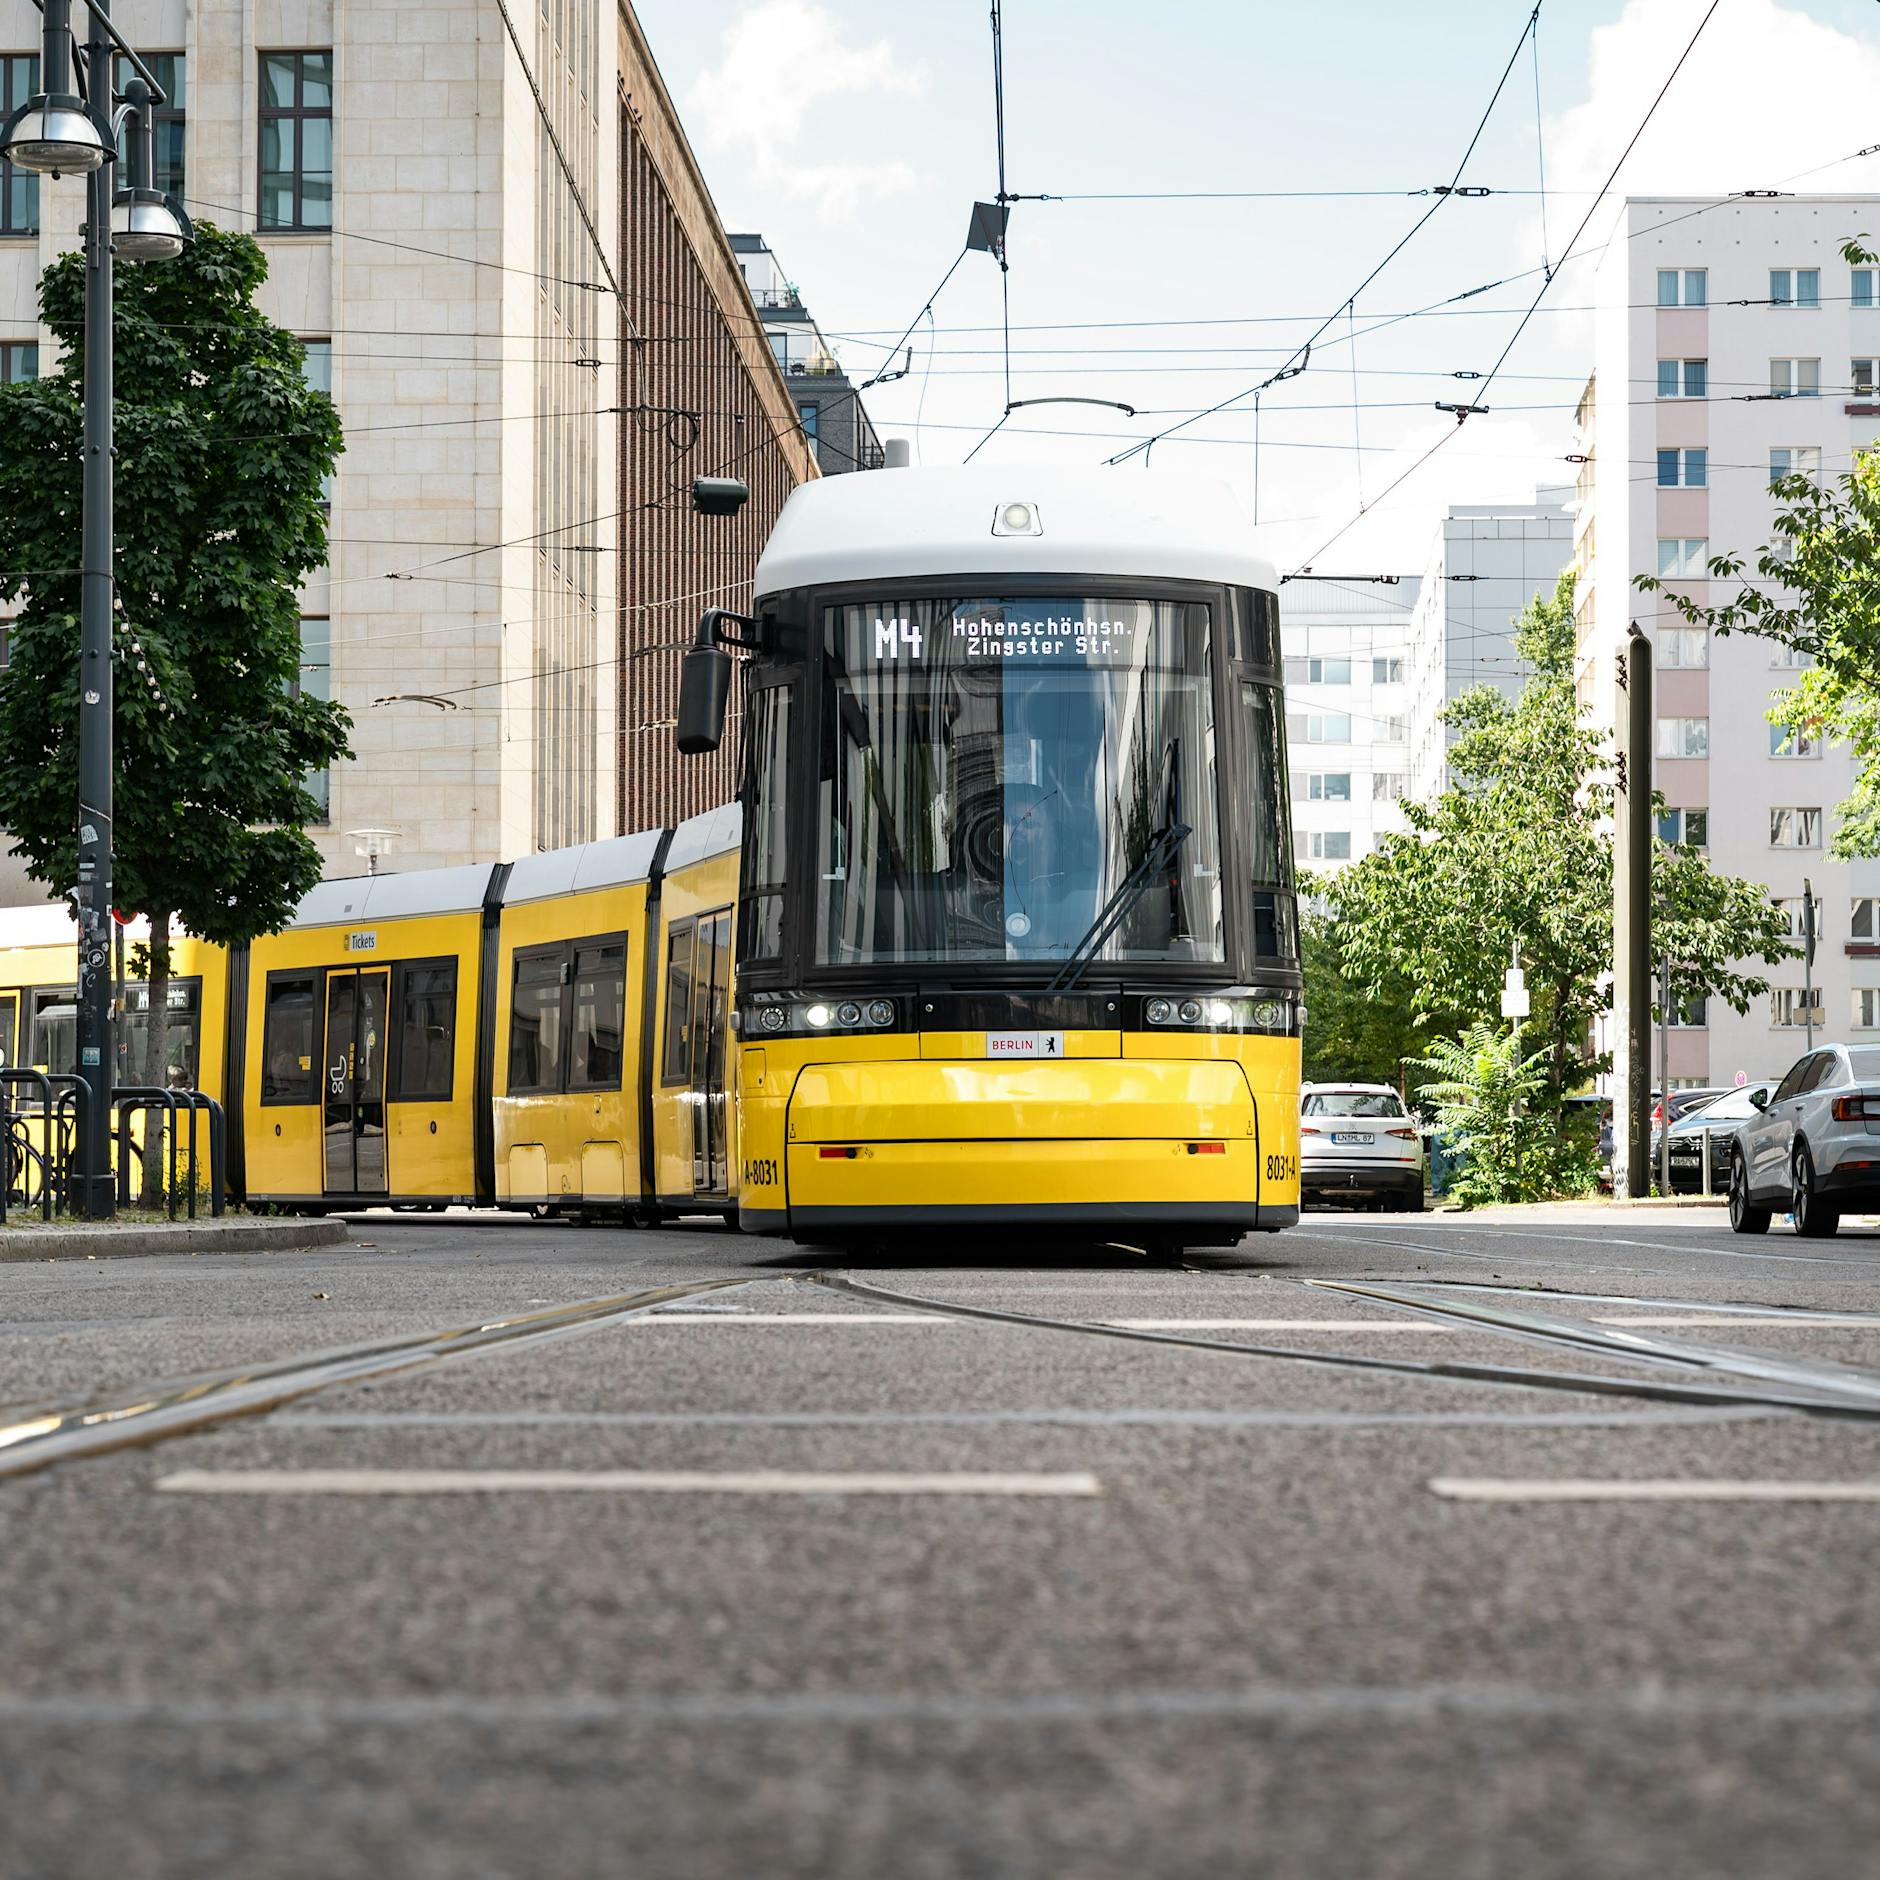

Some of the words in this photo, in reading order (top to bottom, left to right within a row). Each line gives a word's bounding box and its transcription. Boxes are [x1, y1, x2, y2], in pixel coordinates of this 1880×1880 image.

[875, 618, 923, 659] M4
[952, 616, 1132, 637] Hohenschönhsn.
[967, 636, 1064, 656] Zingster
[1075, 635, 1119, 655] Str.
[352, 933, 375, 950] Tickets
[992, 1040, 1033, 1050] BERLIN
[745, 1159, 778, 1185] A-8031
[1267, 1154, 1296, 1181] 8031-A
